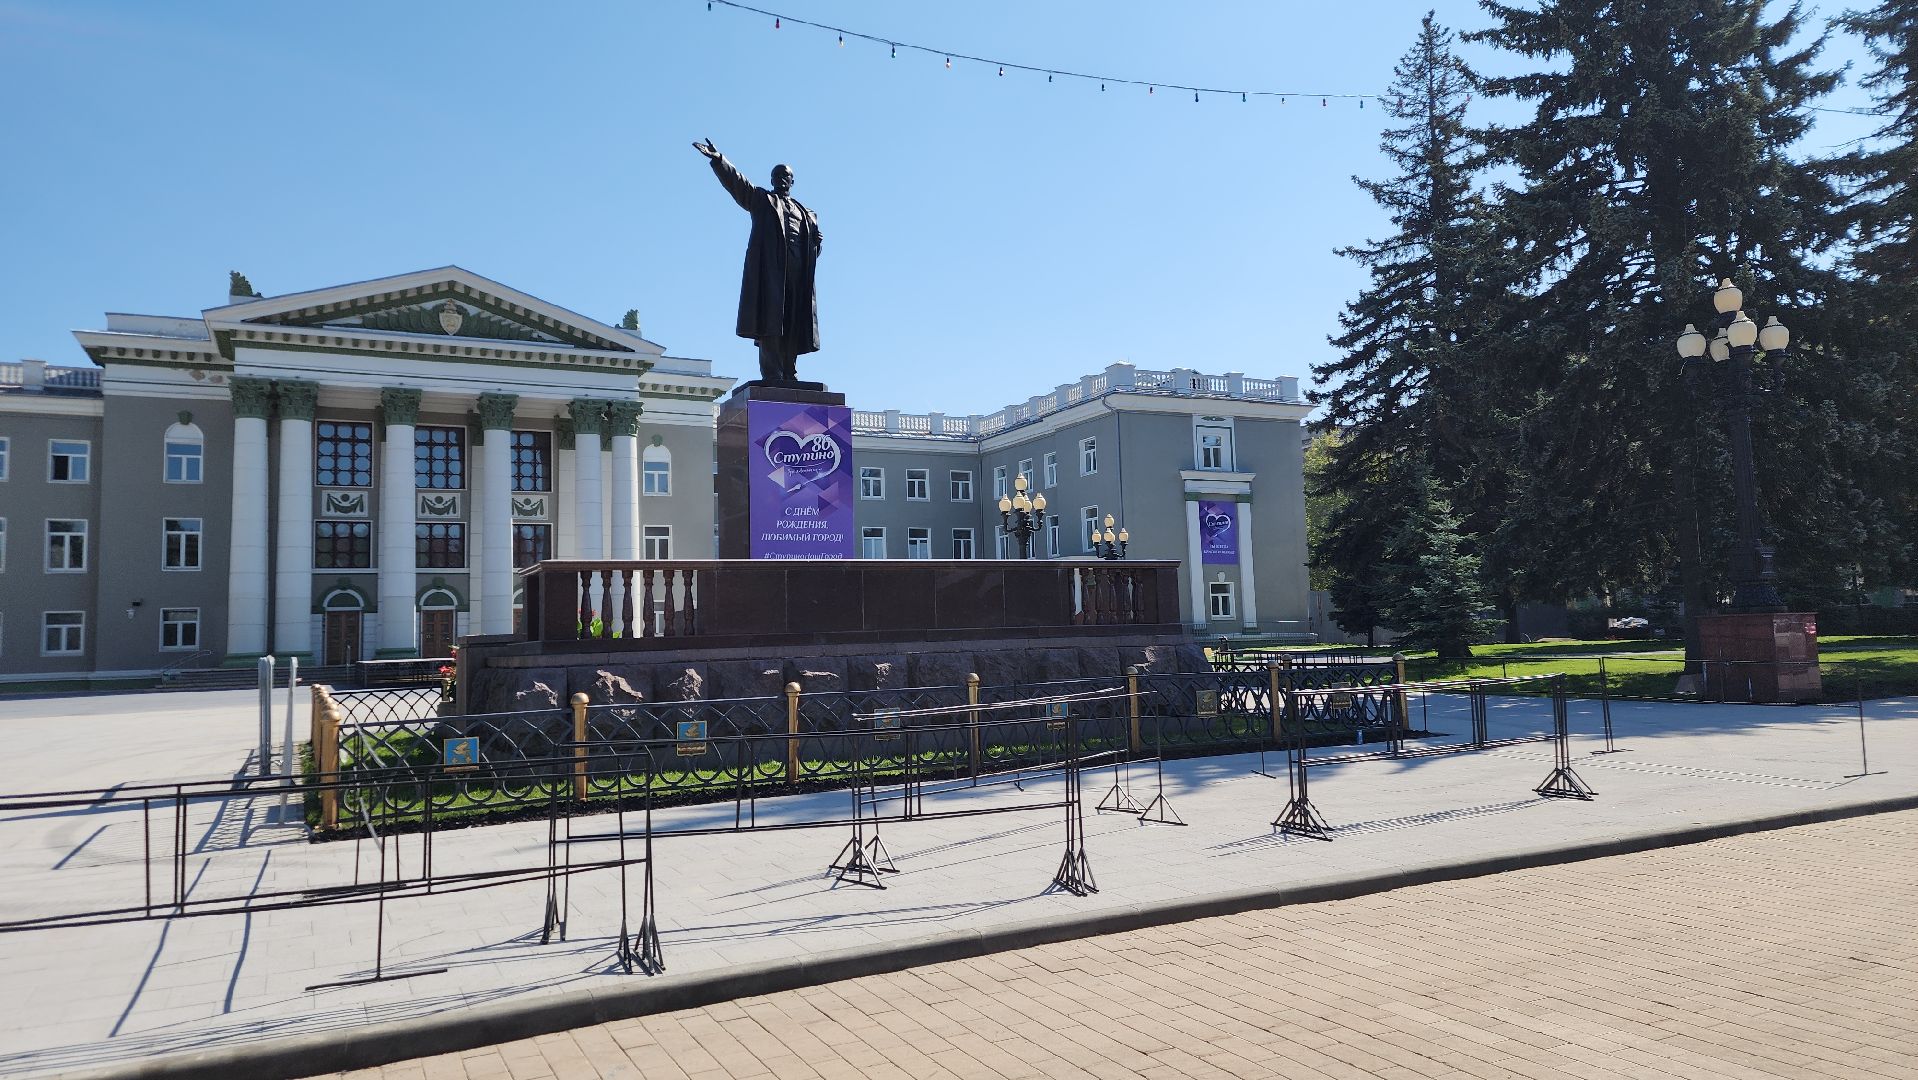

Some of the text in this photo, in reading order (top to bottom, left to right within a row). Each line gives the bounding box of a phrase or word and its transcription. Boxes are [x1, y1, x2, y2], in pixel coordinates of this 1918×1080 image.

[773, 451, 835, 465] Ступино
[785, 505, 820, 517] С ДНЁМ
[761, 533, 844, 543] ЛЮБИМЫЙ ГОРОД!
